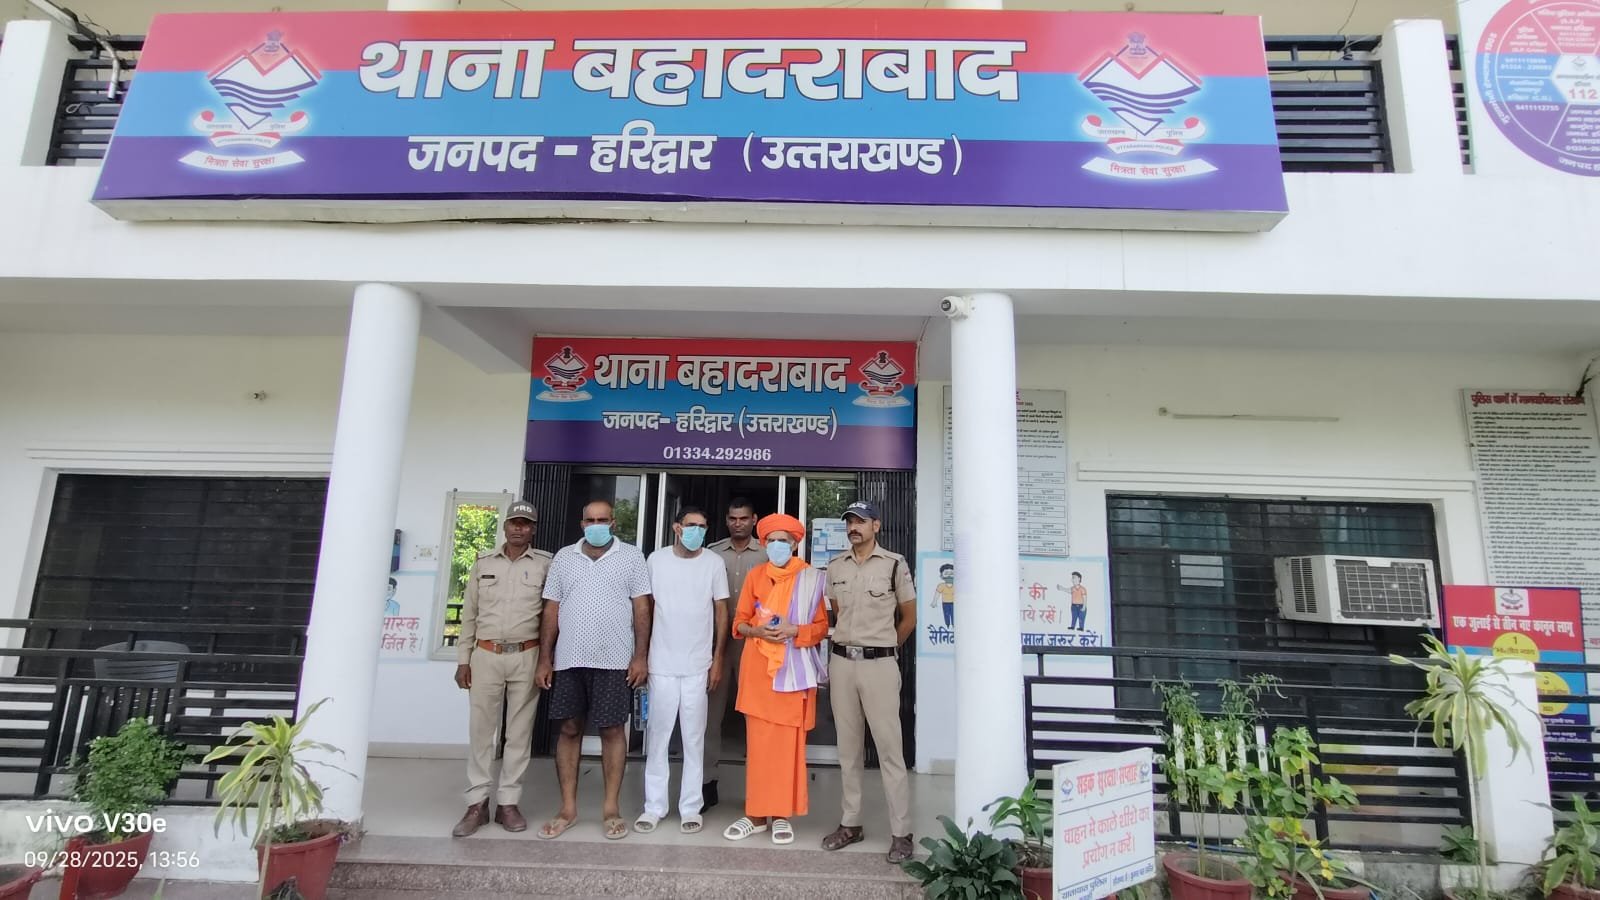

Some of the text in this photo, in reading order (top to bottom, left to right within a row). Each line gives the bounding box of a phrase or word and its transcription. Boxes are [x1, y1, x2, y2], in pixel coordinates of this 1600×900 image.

[358, 38, 1027, 107] थाना बहादराबाद
[1569, 89, 1597, 99] 112
[408, 135, 545, 172] जनपद
[589, 119, 717, 174] हरिद्वार
[594, 354, 851, 395] थाना बहादराबाद
[675, 405, 734, 434] हरिद्वार
[738, 407, 838, 440] (उत्तराखण्ड)
[663, 446, 772, 461] 01334.292986
[1028, 582, 1048, 600] की
[1452, 616, 1466, 628] एक
[1468, 615, 1491, 632] जुलाई
[1502, 616, 1517, 631] तीन
[1063, 824, 1087, 845] वाहन
[1097, 811, 1118, 834] काले
[1138, 806, 1150, 821] का
[1082, 841, 1108, 869] प्रयोग
